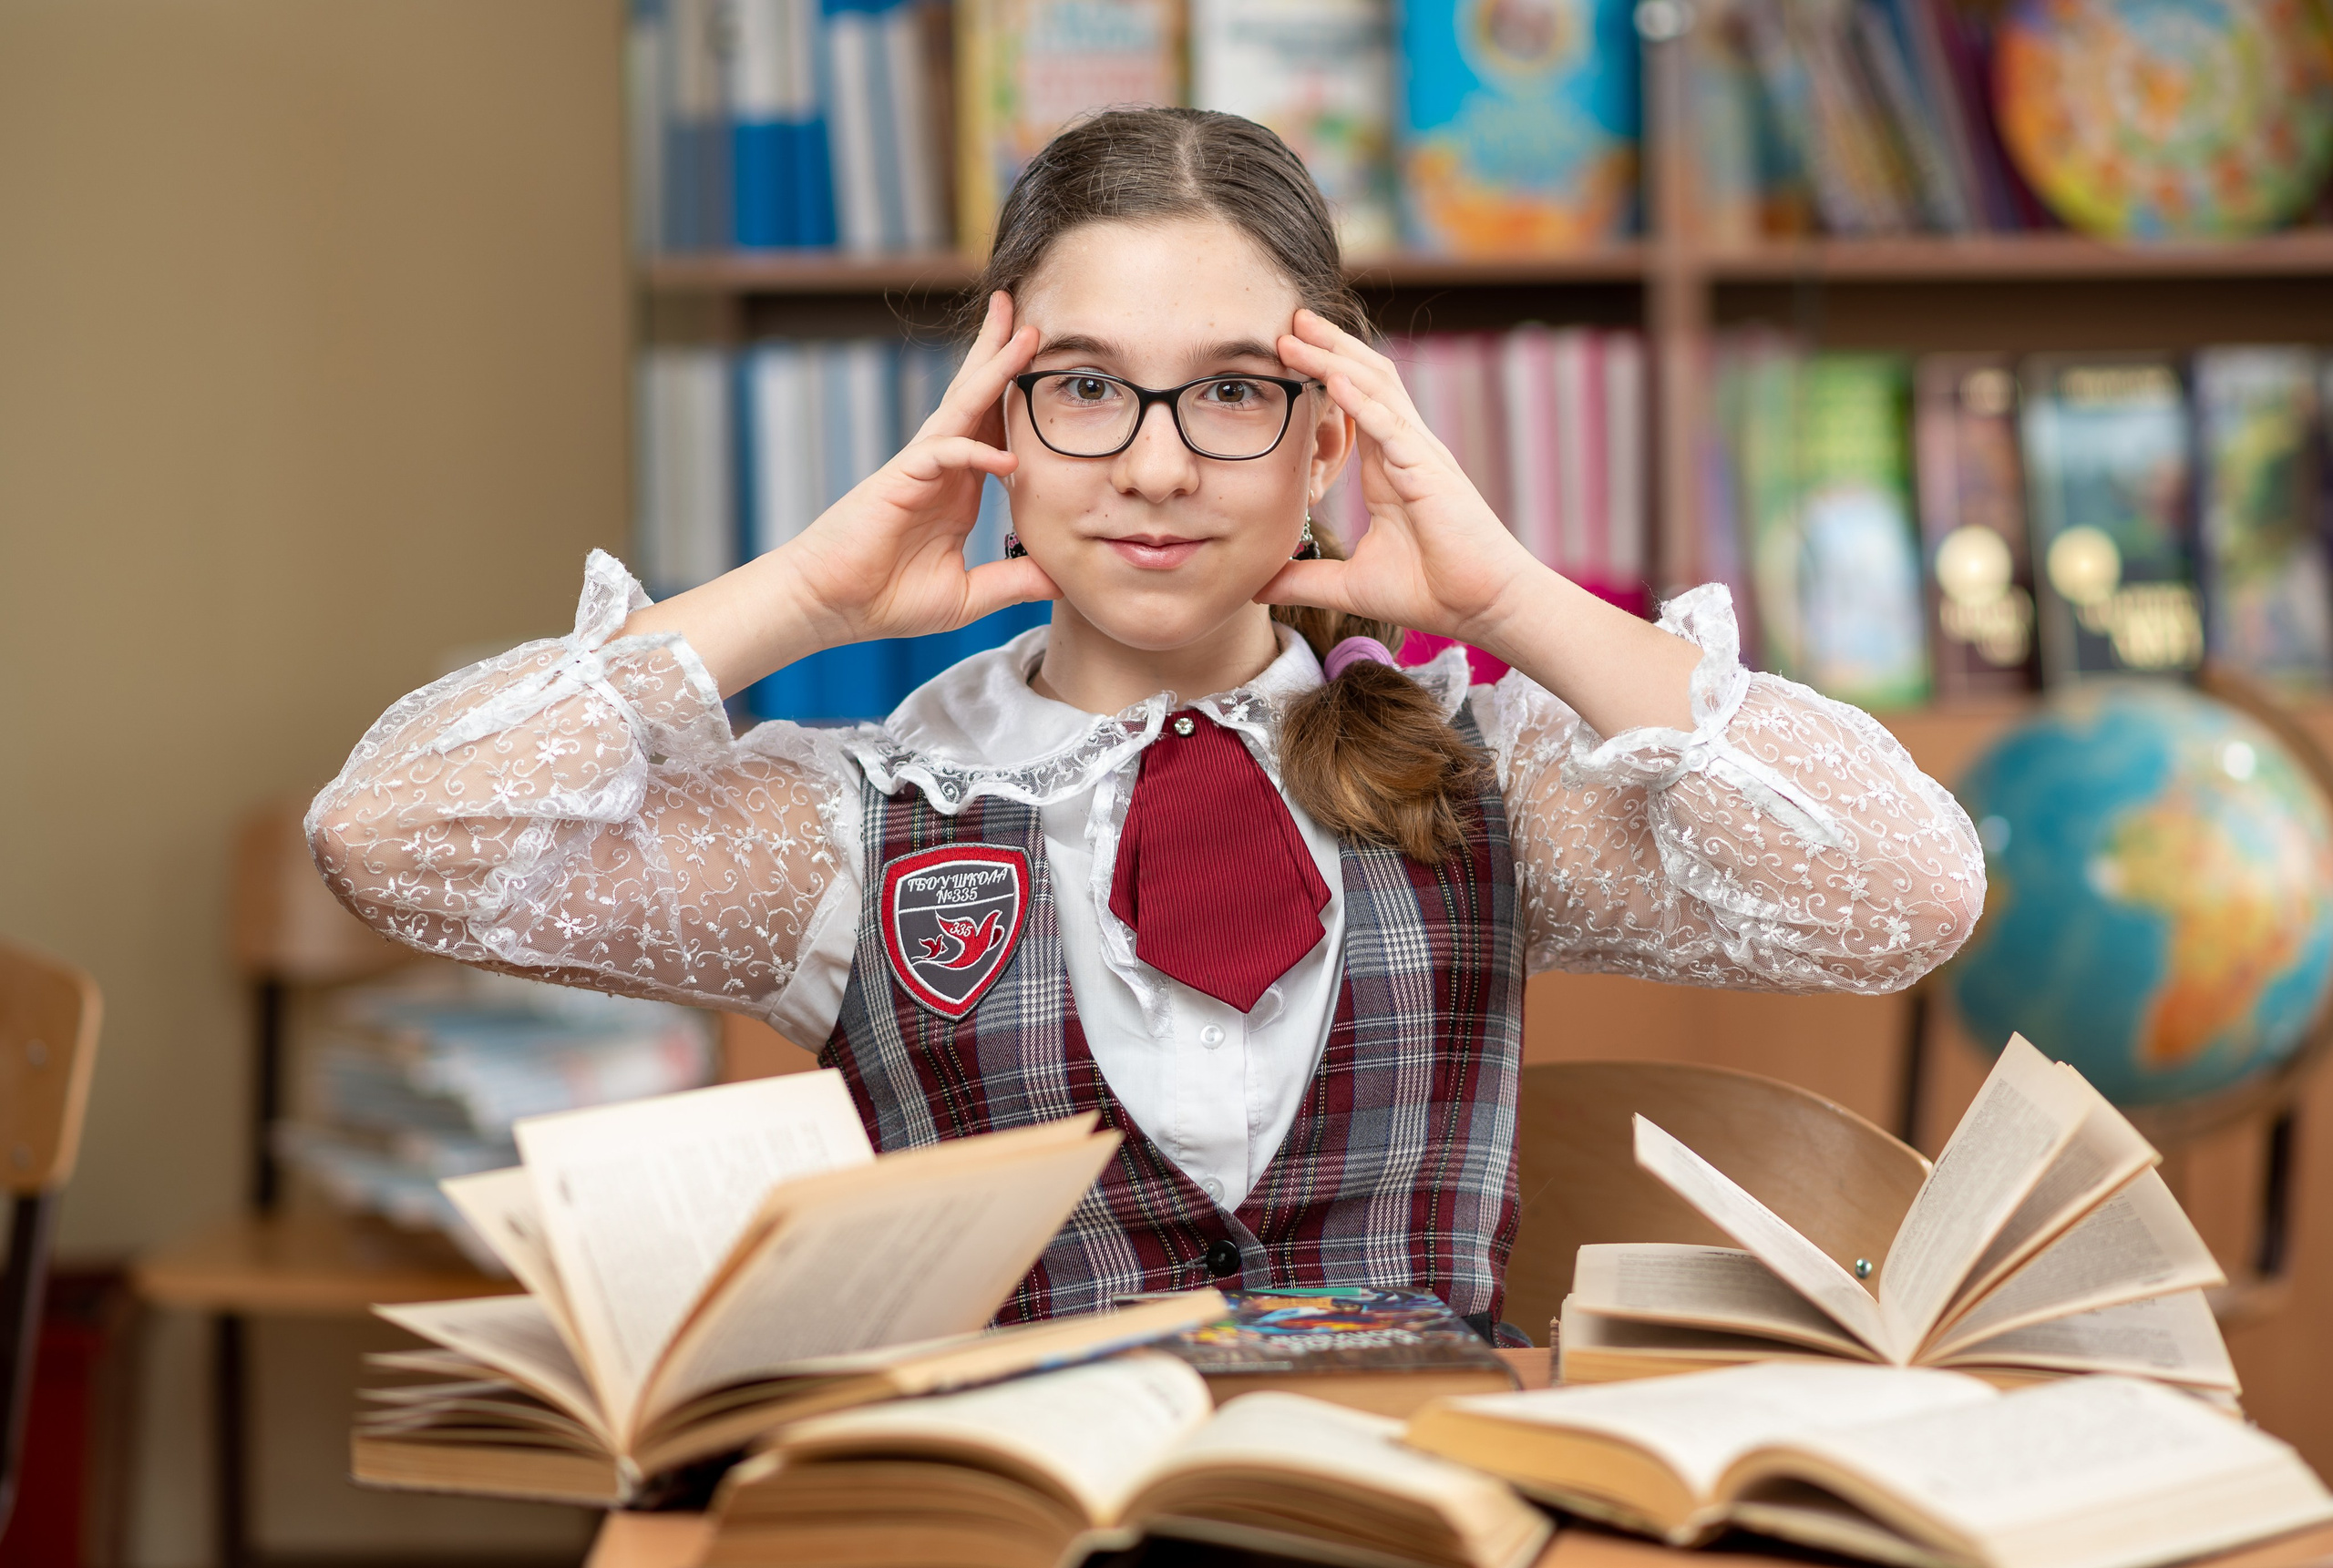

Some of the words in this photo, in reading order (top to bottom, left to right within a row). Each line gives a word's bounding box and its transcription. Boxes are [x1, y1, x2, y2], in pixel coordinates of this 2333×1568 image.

[952, 867, 1008, 887] ШКОЛА
[936, 887, 978, 904] №335
[950, 922, 973, 937] 335
